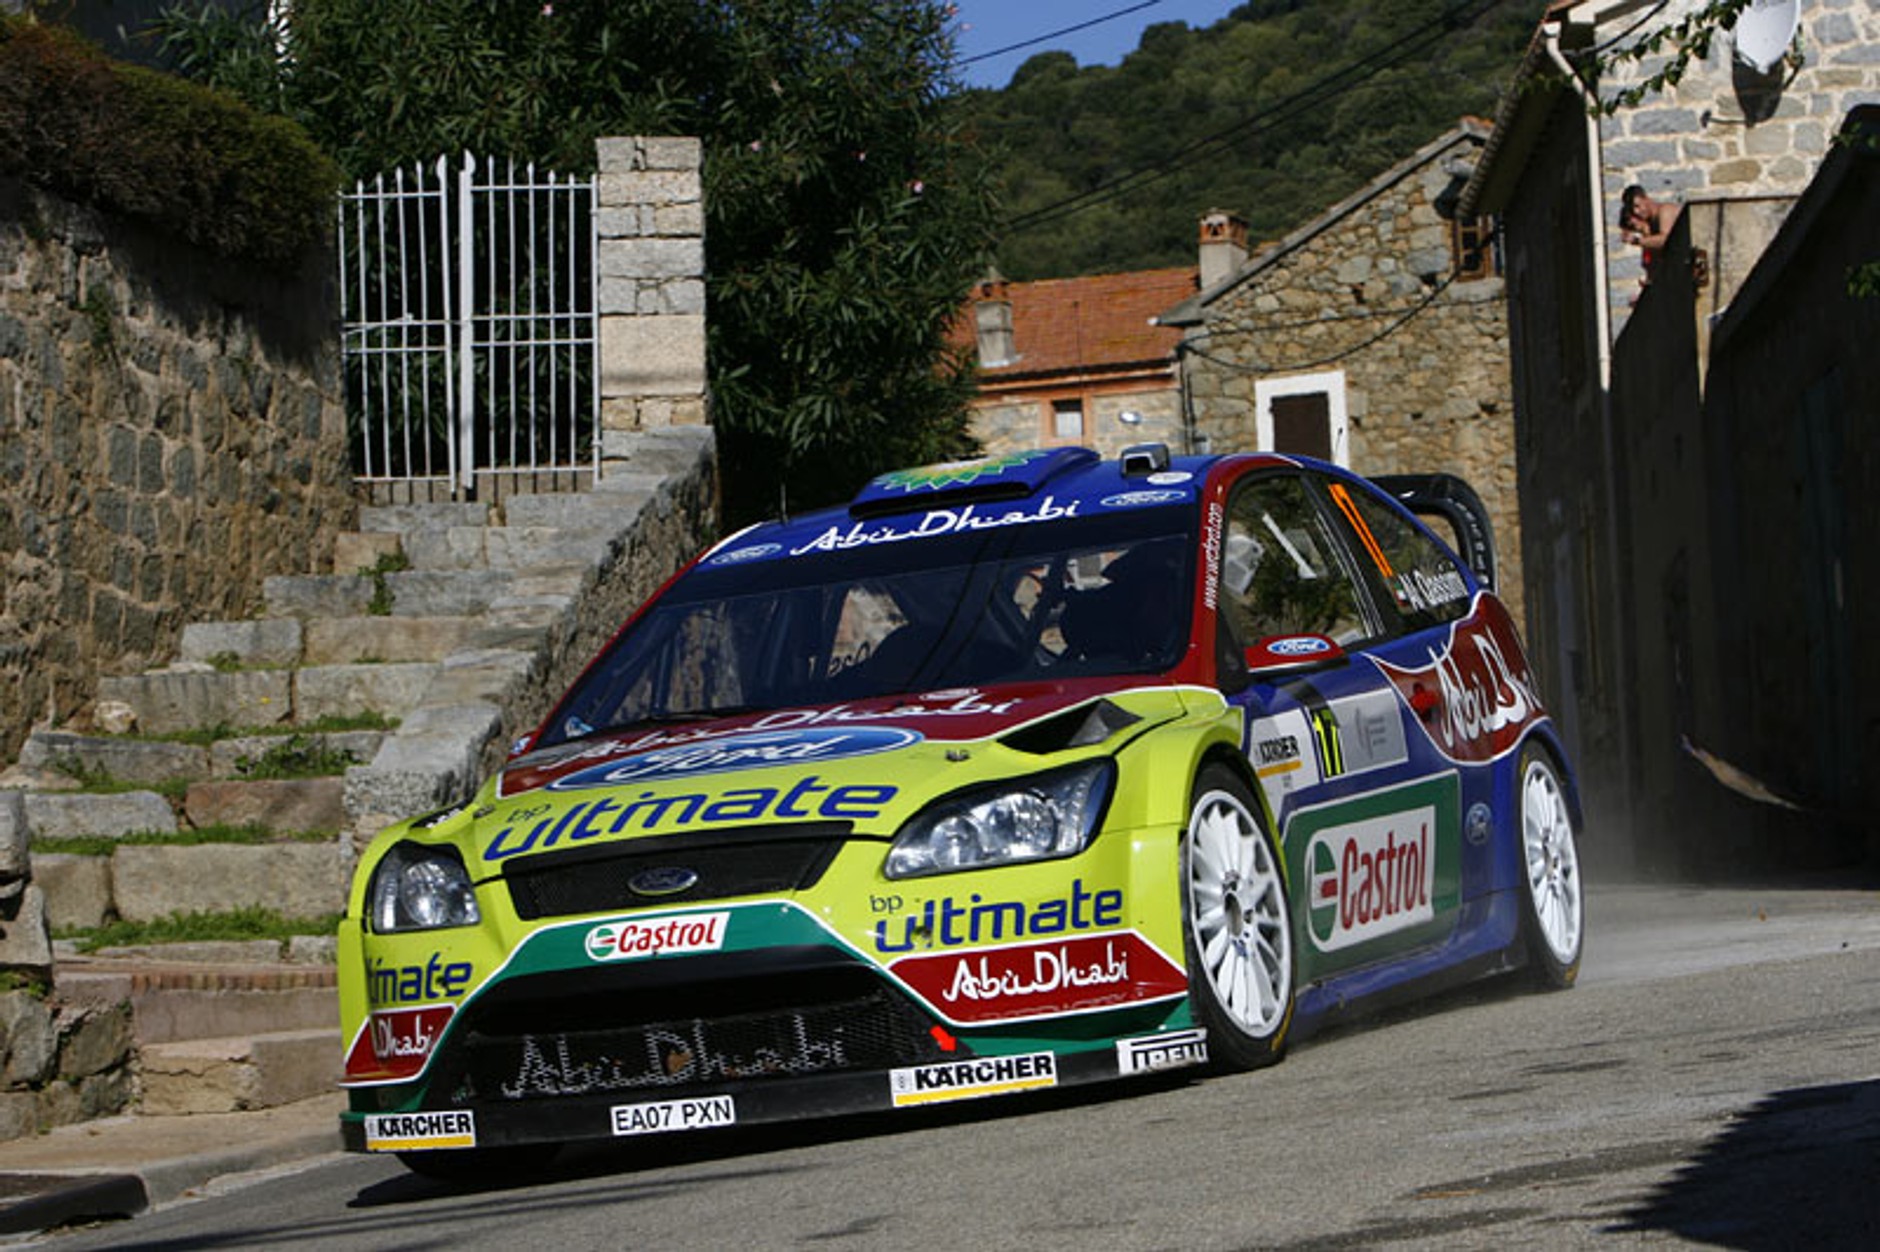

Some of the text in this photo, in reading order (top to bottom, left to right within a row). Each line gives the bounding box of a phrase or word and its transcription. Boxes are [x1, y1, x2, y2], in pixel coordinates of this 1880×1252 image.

[790, 496, 1080, 555] Abu Dhabi
[540, 726, 748, 770] Abu
[745, 692, 1021, 734] Dhabi
[605, 731, 856, 783] Ford
[484, 776, 898, 860] ultimate
[870, 894, 903, 914] bp
[1341, 822, 1427, 931] Castrol
[618, 916, 717, 953] Castrol
[876, 879, 1123, 953] ultimate
[942, 941, 1129, 1002] Abu Dhabi
[502, 1014, 848, 1099] Abu Dhabi
[914, 1055, 1053, 1090] KÄRCHER
[377, 1113, 472, 1138] KÄRCHER
[614, 1099, 732, 1132] EA07 PXN
